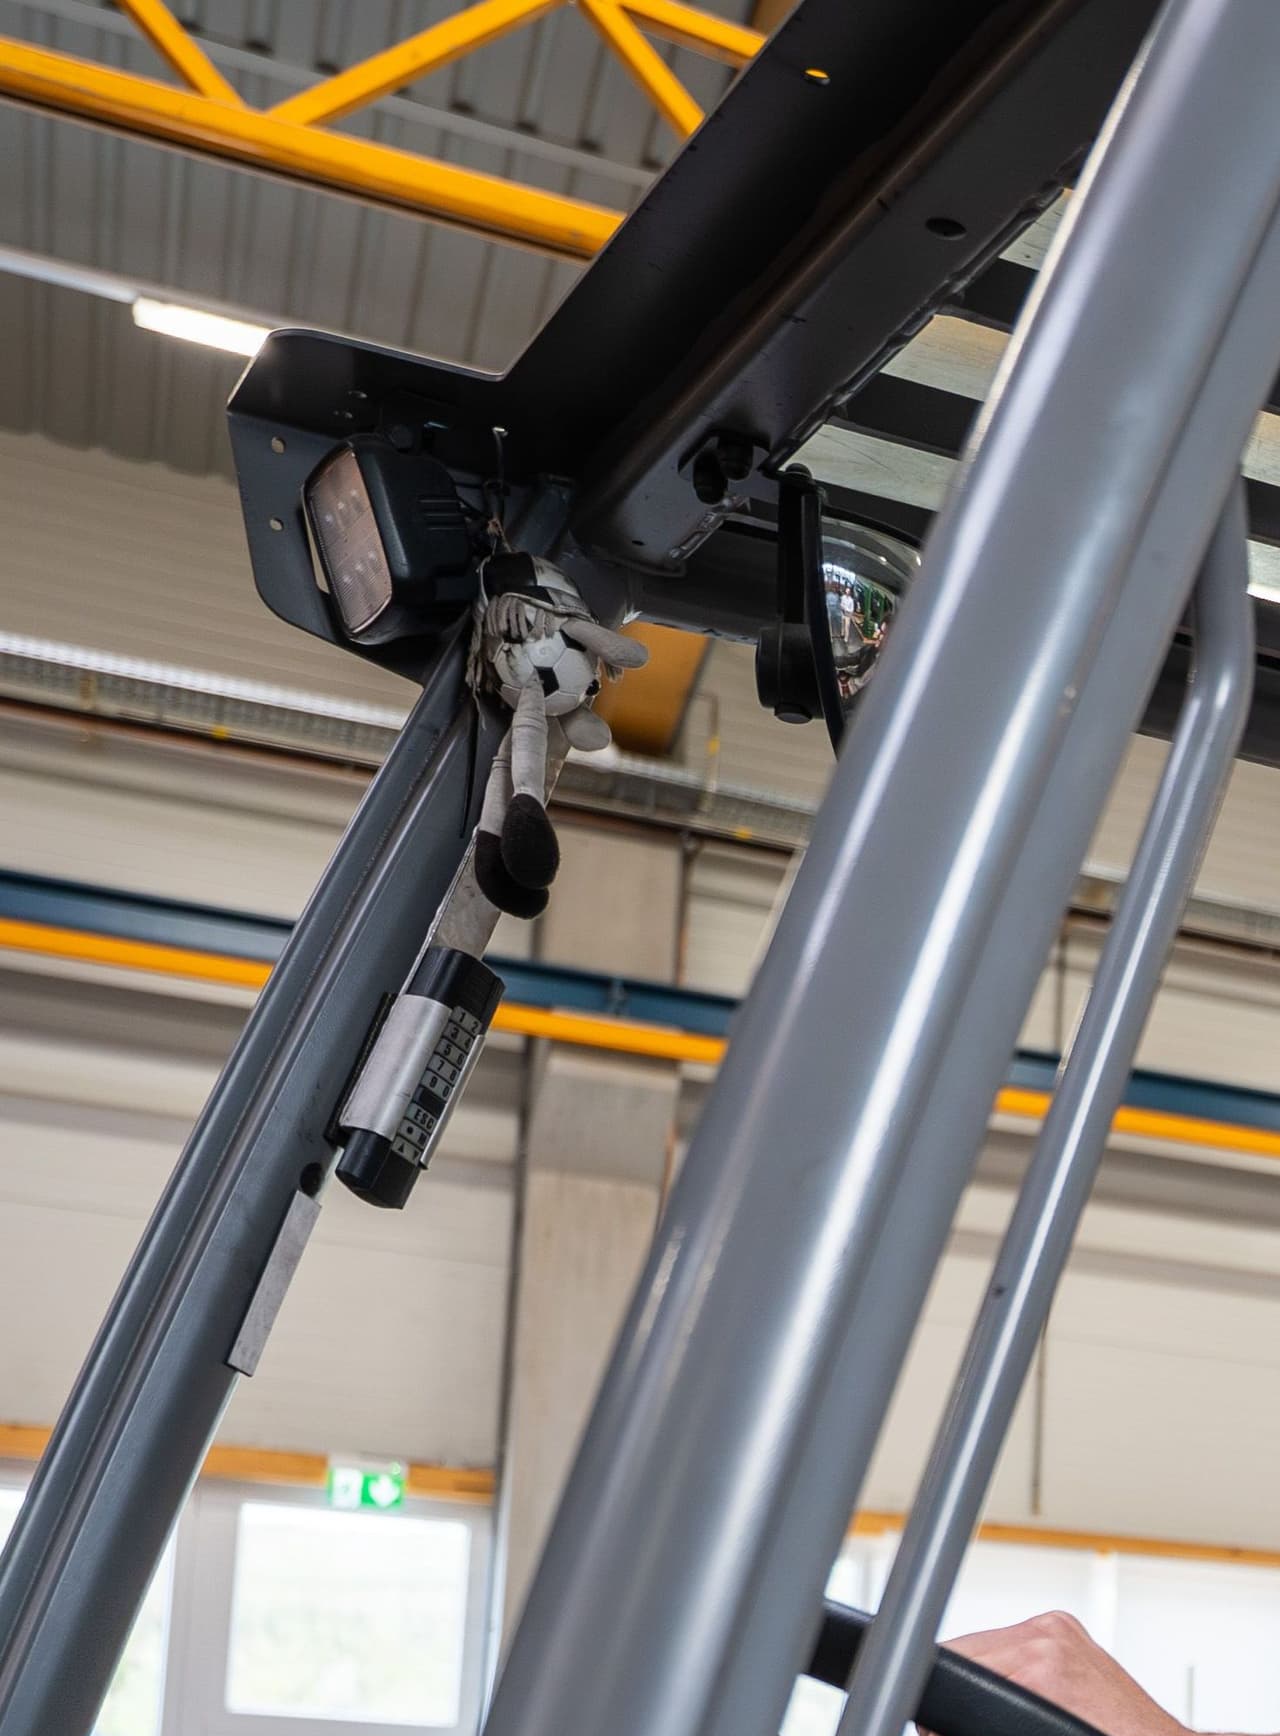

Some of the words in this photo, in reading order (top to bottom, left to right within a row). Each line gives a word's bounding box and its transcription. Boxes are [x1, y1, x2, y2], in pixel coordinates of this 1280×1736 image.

[459, 1011, 466, 1022] 1
[471, 1021, 479, 1033] 2
[437, 1059, 445, 1071] 7
[414, 1108, 435, 1130] ESC
